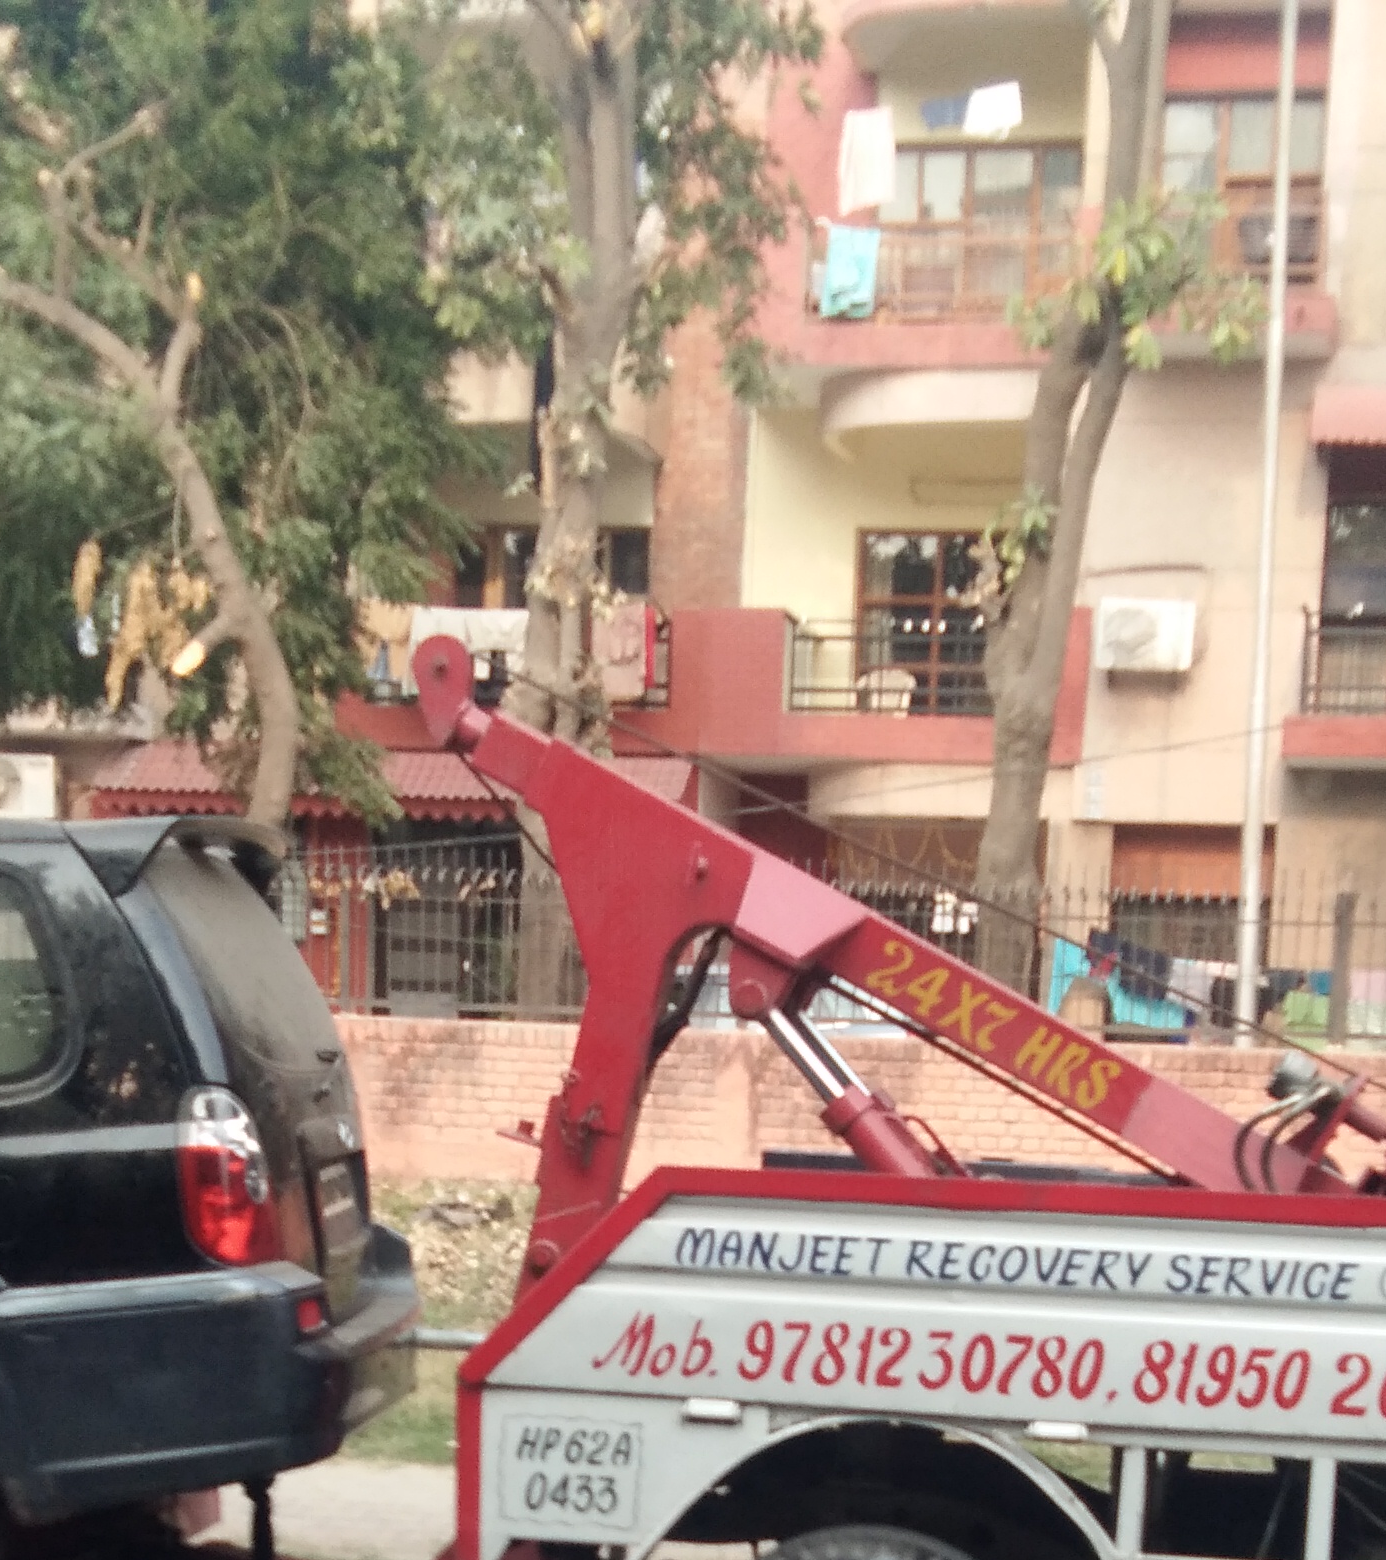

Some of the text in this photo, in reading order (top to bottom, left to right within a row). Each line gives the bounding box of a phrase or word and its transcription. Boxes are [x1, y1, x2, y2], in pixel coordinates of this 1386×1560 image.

[866, 939, 1123, 1109] 24X7 HRS
[675, 1226, 892, 1276] MANJEET
[905, 1240, 1153, 1292] RECOVERY
[1165, 1254, 1360, 1301] SERVICE
[592, 1311, 719, 1378] Mob.
[524, 1471, 620, 1516] 0433
